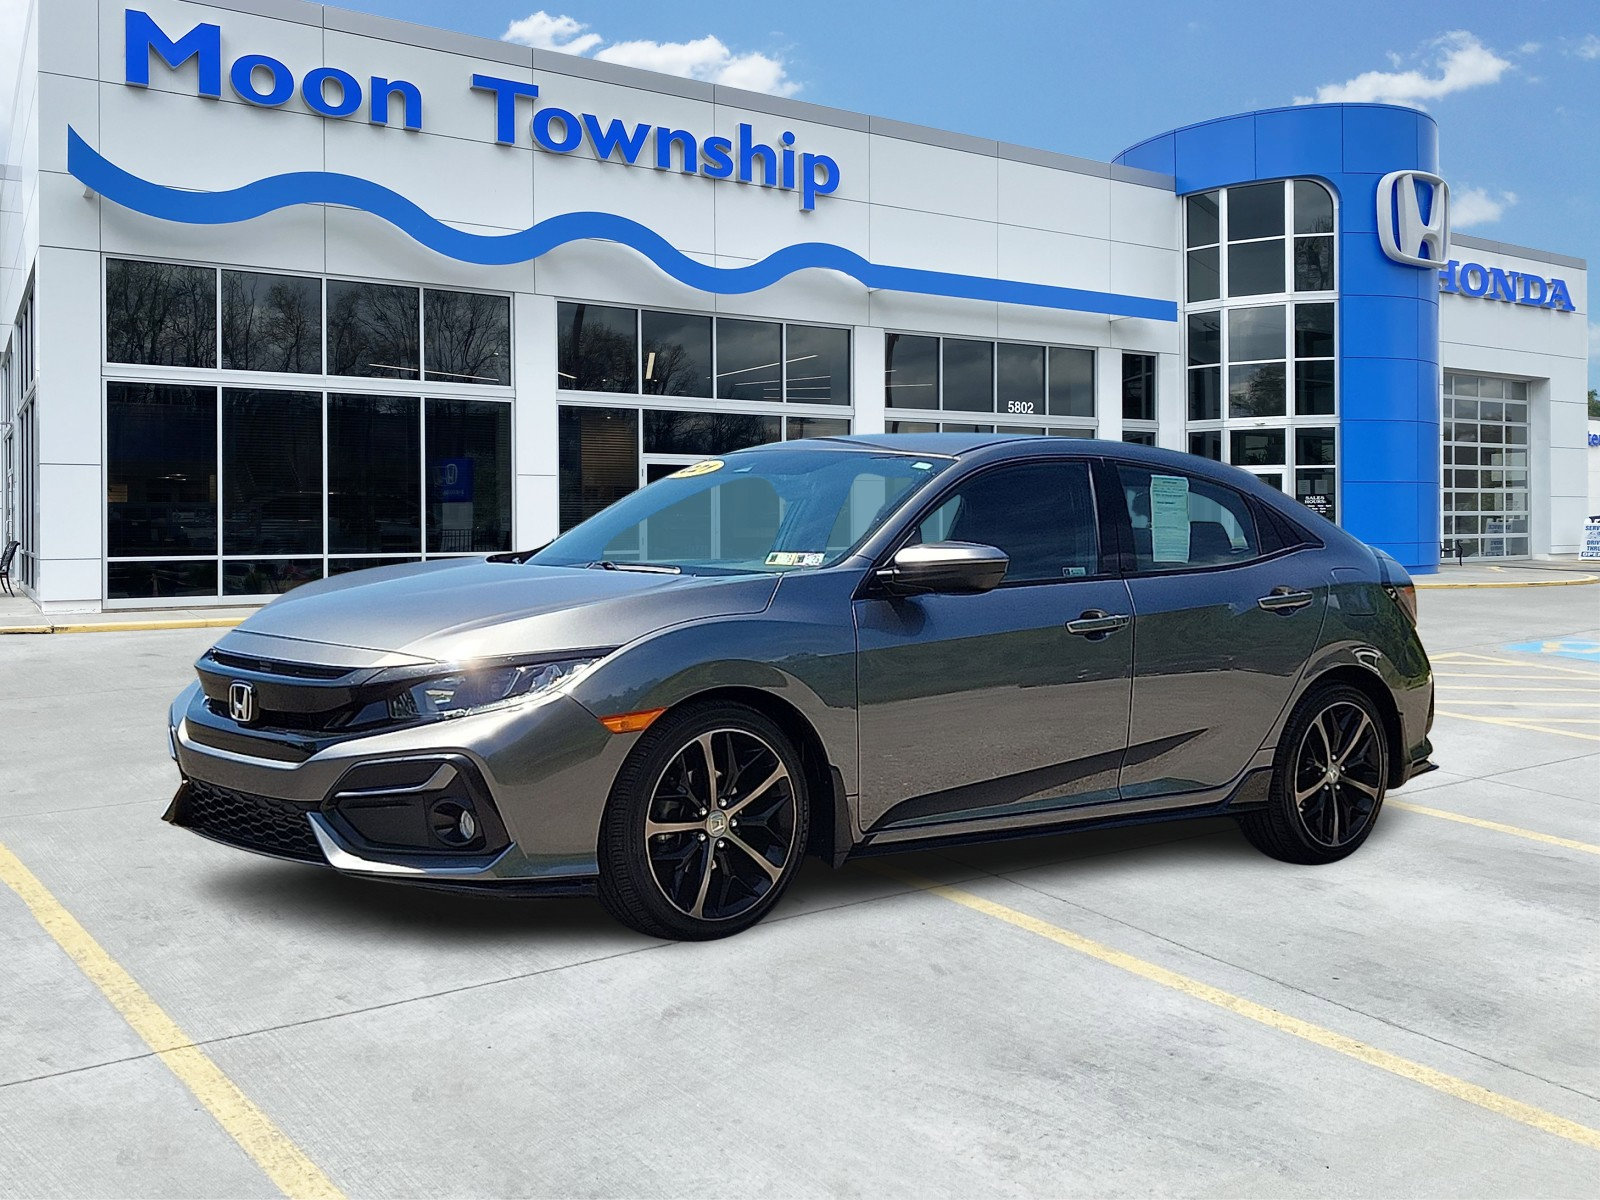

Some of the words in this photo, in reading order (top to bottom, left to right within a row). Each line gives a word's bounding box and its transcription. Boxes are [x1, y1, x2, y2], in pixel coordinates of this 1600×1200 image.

[124, 8, 422, 131] Moon
[469, 73, 841, 213] Township
[1438, 259, 1576, 312] HONDA
[1007, 400, 1034, 414] 5802
